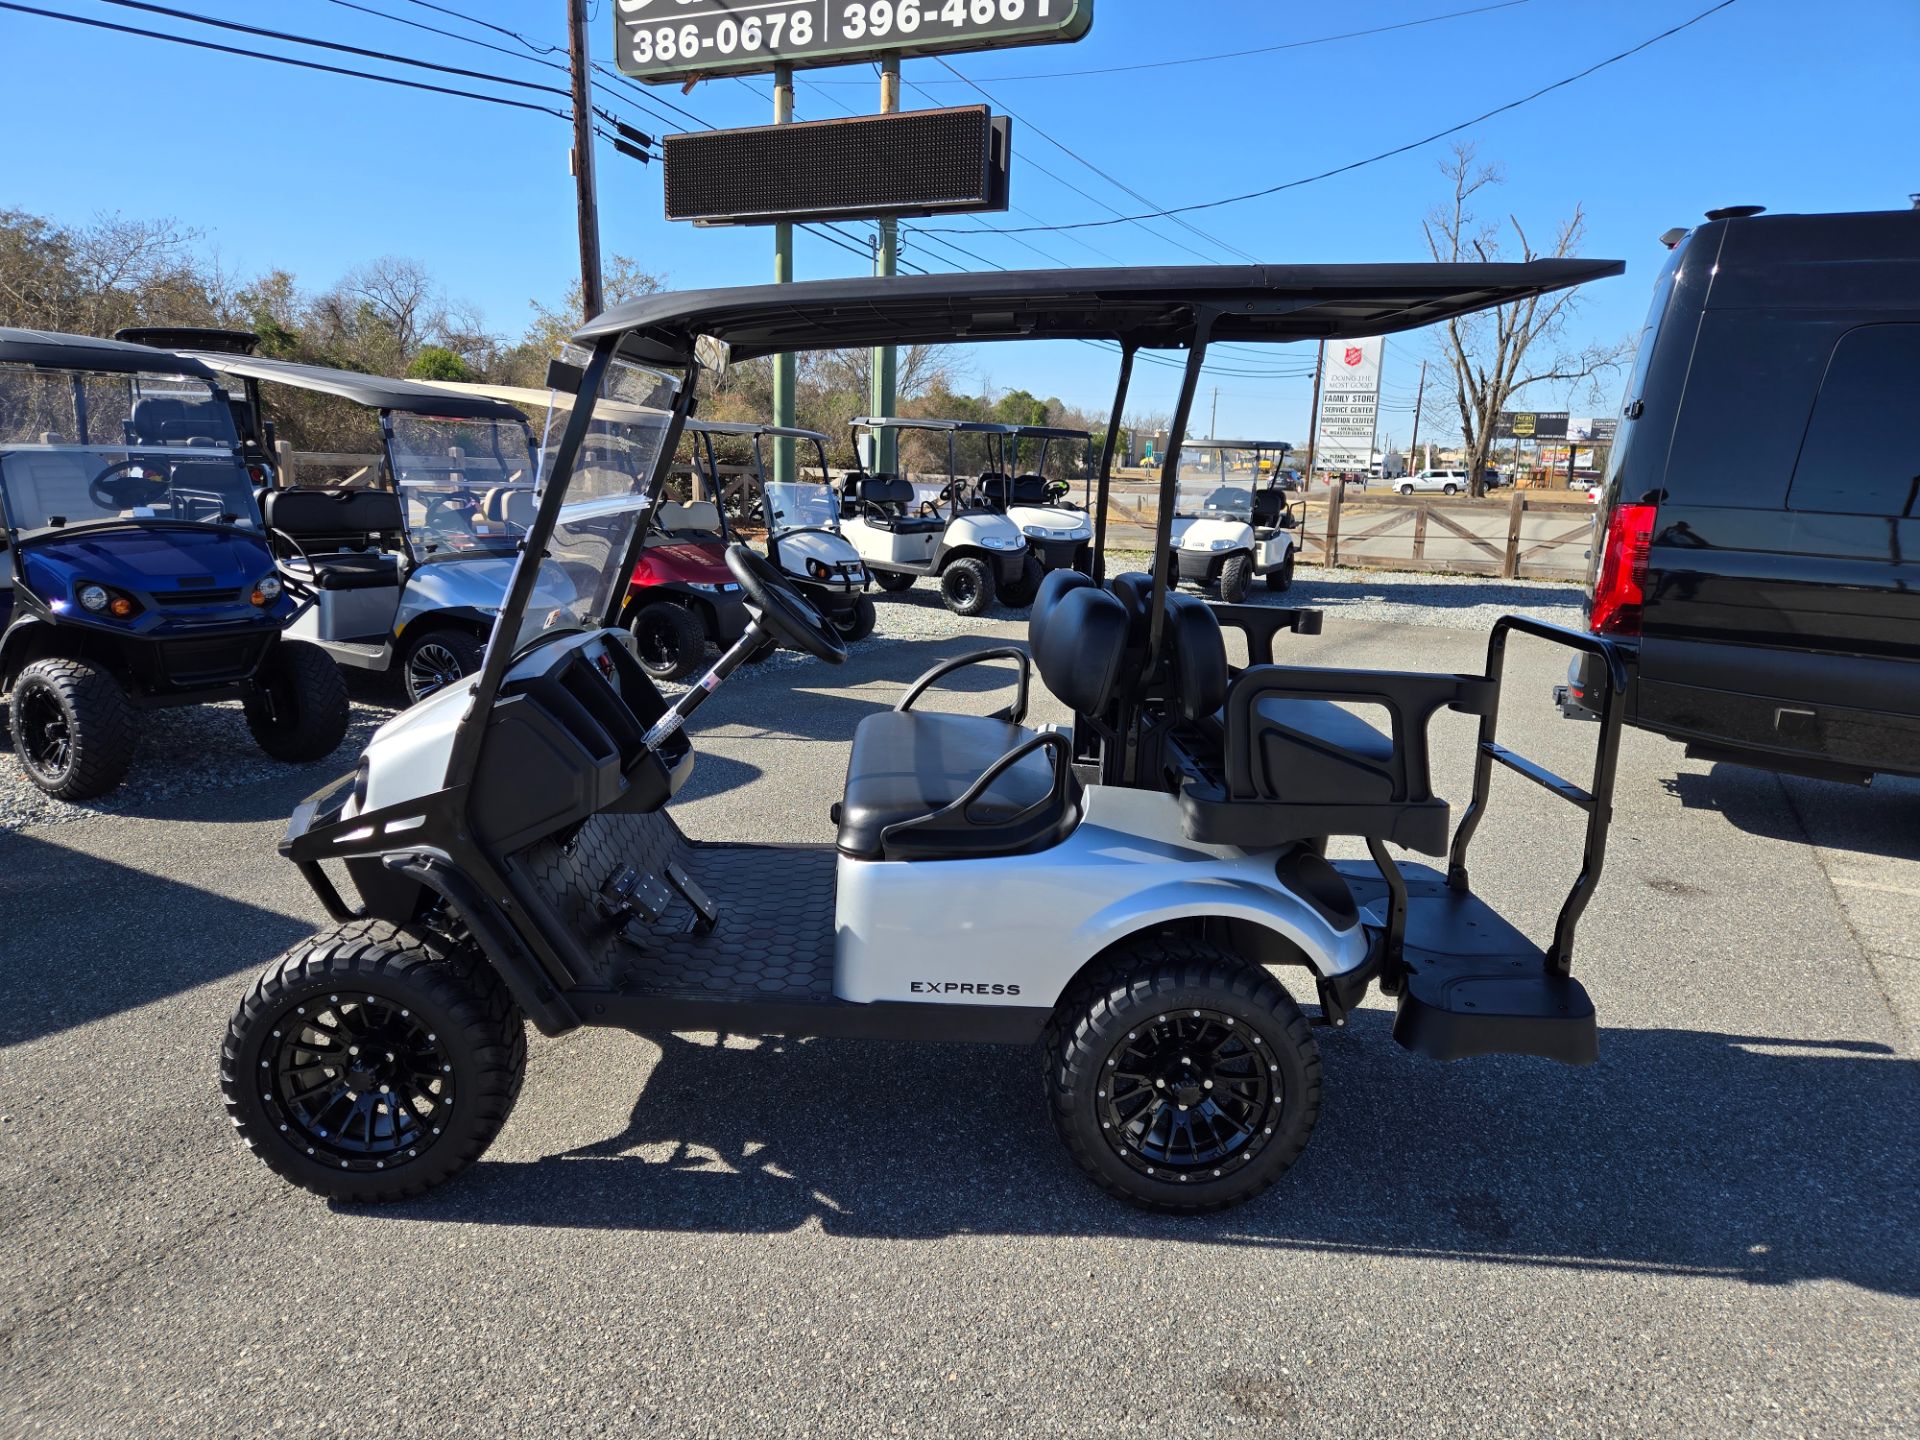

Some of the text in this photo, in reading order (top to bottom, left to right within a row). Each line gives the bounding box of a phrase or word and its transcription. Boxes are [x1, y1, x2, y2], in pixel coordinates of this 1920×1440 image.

[633, 10, 813, 63] 386-0678
[1324, 394, 1375, 402] FAMILY STORE
[910, 981, 1021, 996] EXPRESS
